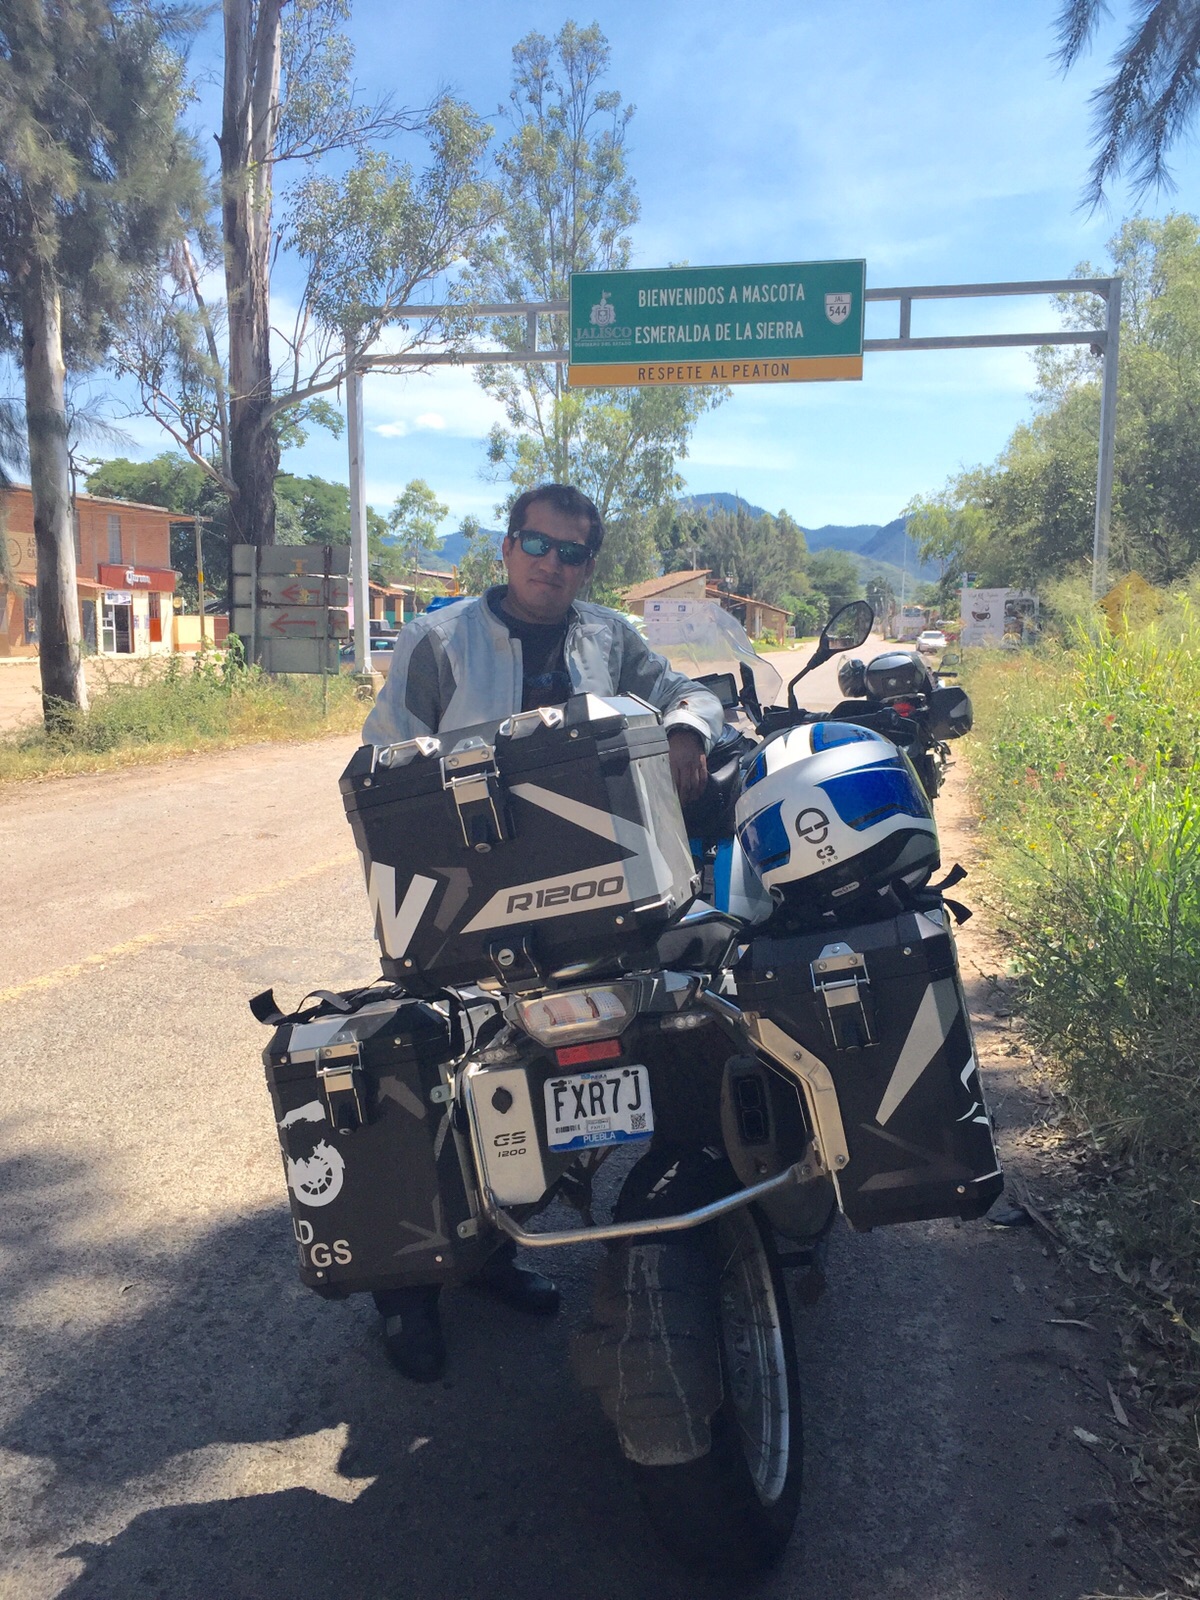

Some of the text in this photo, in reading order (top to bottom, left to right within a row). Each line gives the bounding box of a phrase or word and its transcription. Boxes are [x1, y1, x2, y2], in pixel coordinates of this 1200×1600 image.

[638, 283, 806, 308] BIENVENIDOS A MASCOTA
[829, 305, 847, 317] 544
[574, 326, 632, 342] JALISCO
[635, 321, 804, 344] ESMERALDA DE LA SIERRA
[638, 363, 790, 381] RESPETE AL PEATON
[506, 876, 625, 915] R1200
[553, 1075, 642, 1122] FXR7J
[493, 1130, 527, 1148] GS
[583, 1132, 616, 1144] PUEBLA
[497, 1148, 527, 1158] 1200
